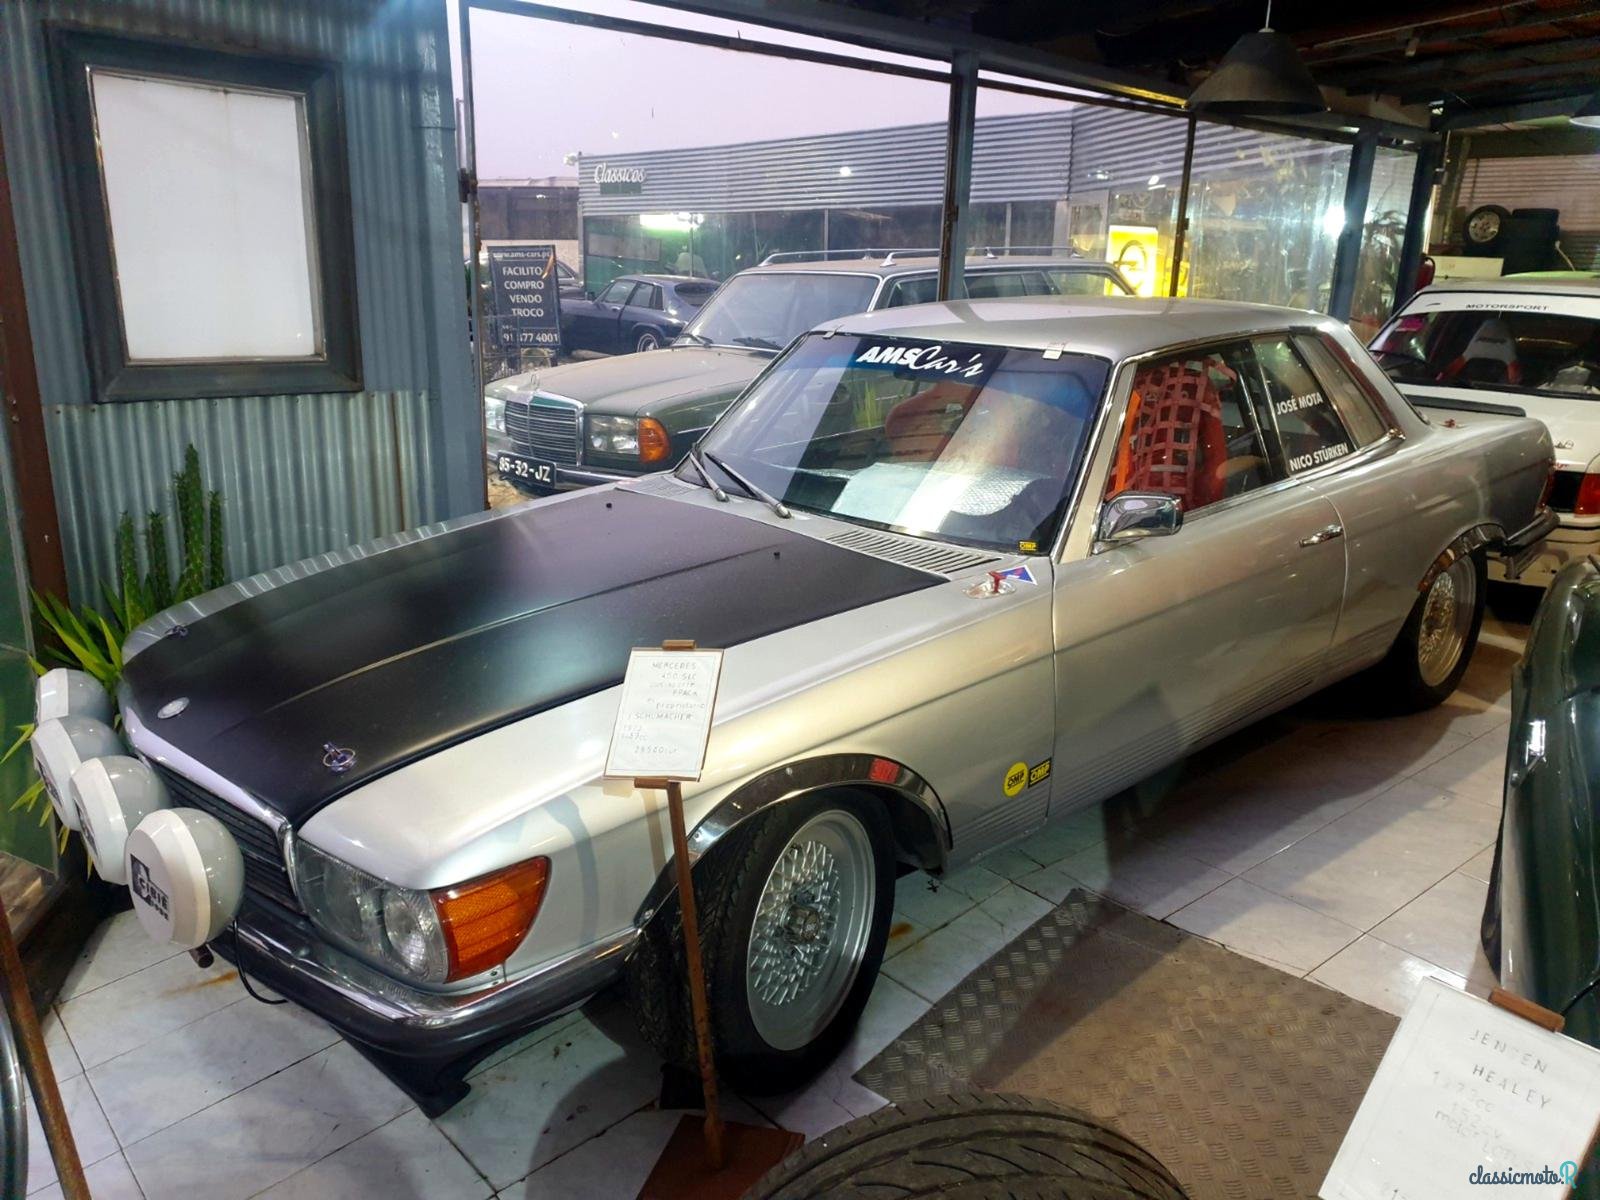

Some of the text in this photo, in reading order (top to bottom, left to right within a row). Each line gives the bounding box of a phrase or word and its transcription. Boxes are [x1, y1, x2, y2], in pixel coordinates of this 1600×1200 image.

[594, 162, 648, 184] Classicos
[502, 266, 543, 276] FACILITO
[504, 280, 545, 290] COMPRO
[509, 294, 542, 304] VENDO
[1465, 303, 1550, 311] MOTORSPORT
[511, 308, 544, 317] TROCO
[536, 333, 558, 342] 4001
[1276, 391, 1324, 415] JOSÉ MOTA
[1289, 454, 1313, 472] NICO
[651, 661, 697, 670] MERCEDES
[1472, 1064, 1552, 1110] HEALEY
